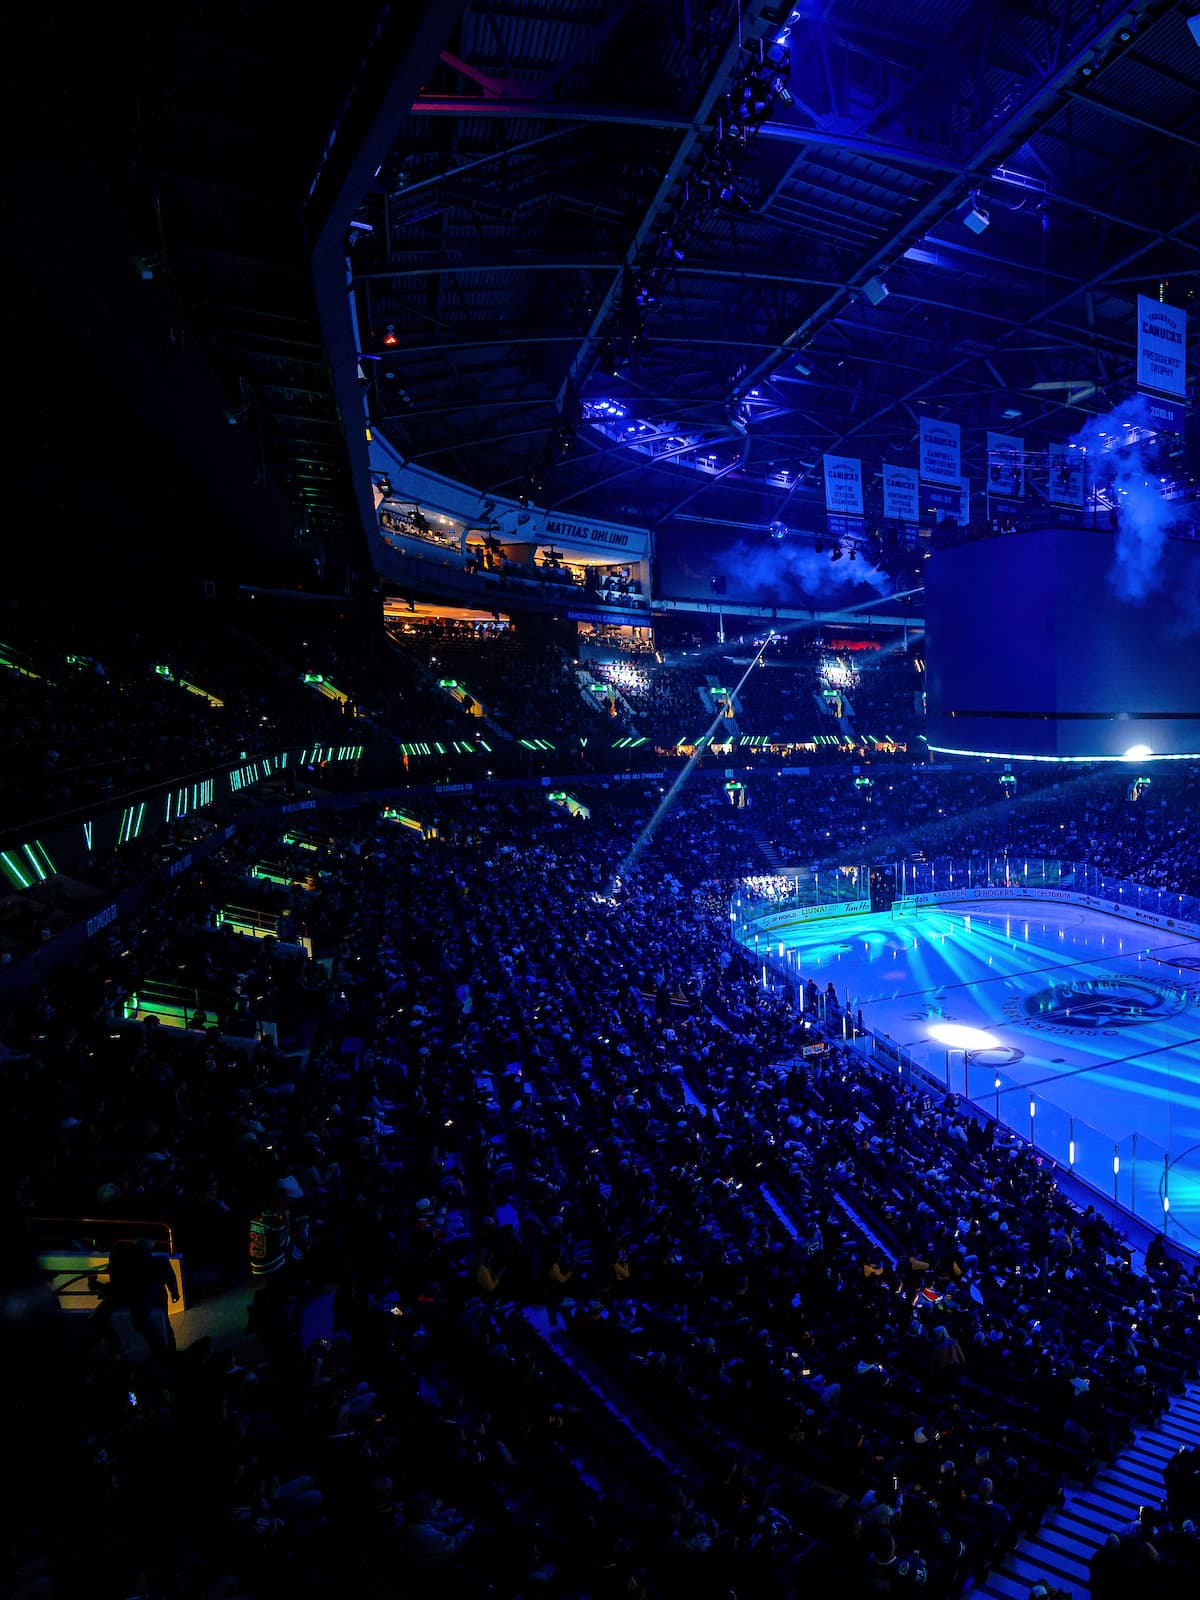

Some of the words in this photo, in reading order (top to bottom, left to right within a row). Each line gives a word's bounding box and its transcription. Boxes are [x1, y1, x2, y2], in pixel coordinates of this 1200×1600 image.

[1142, 321, 1182, 345] CANUCKS
[828, 470, 859, 481] CANUCKS
[480, 502, 495, 521] 2
[545, 521, 590, 540] MATTIAS
[590, 530, 629, 546] OHLUND
